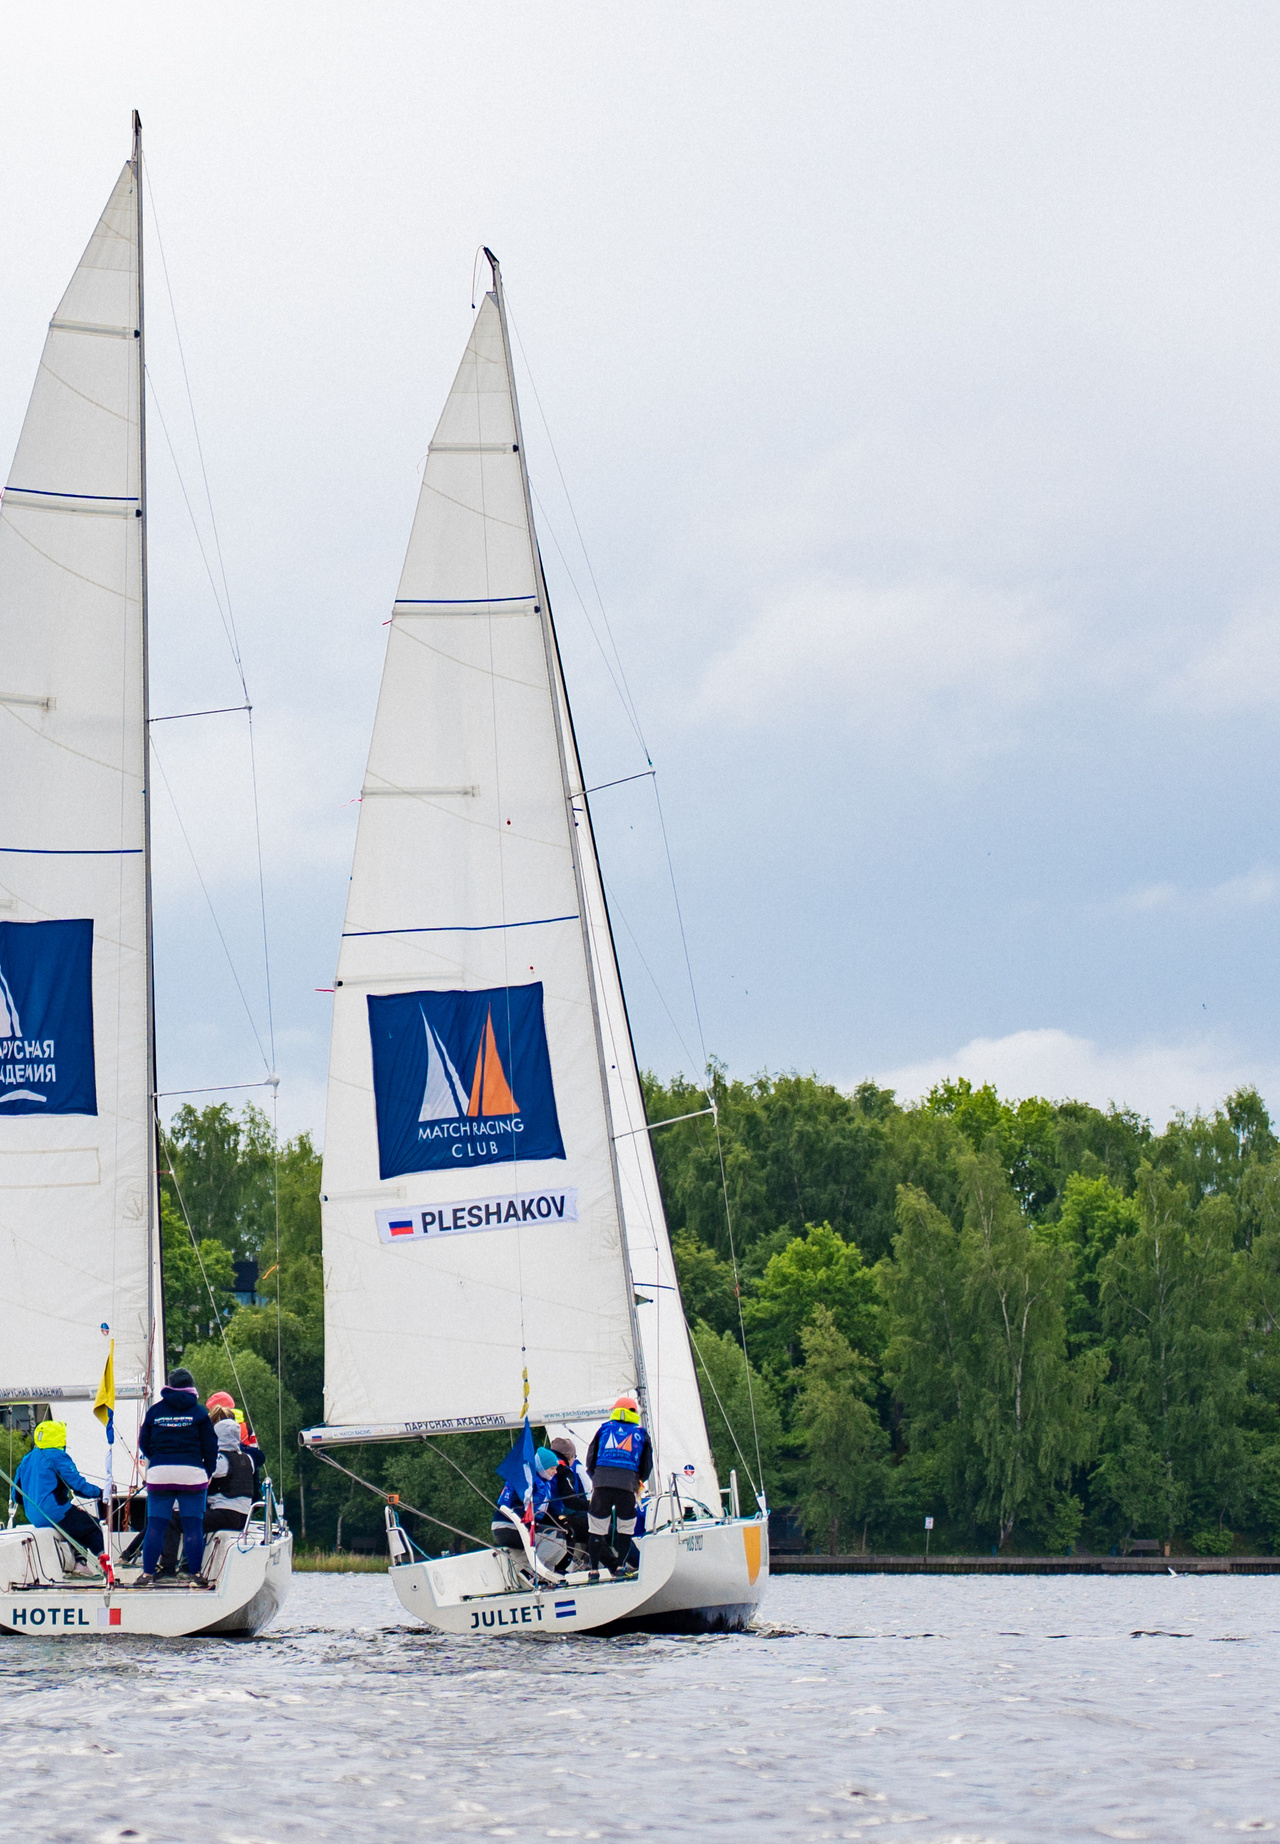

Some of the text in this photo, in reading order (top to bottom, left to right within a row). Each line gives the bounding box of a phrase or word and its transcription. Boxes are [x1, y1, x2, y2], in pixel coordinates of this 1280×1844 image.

[418, 1118, 525, 1141] MATCH RACING
[451, 1141, 499, 1158] CLUB
[421, 1195, 566, 1234] PLESHAKOV
[32, 1387, 64, 1398] АКАДЕМИЯ
[404, 1415, 507, 1432] ПАРУСНАЯ АКАДЕМИЯ
[12, 1608, 90, 1626] HOTEL
[470, 1604, 545, 1629] JULIET
